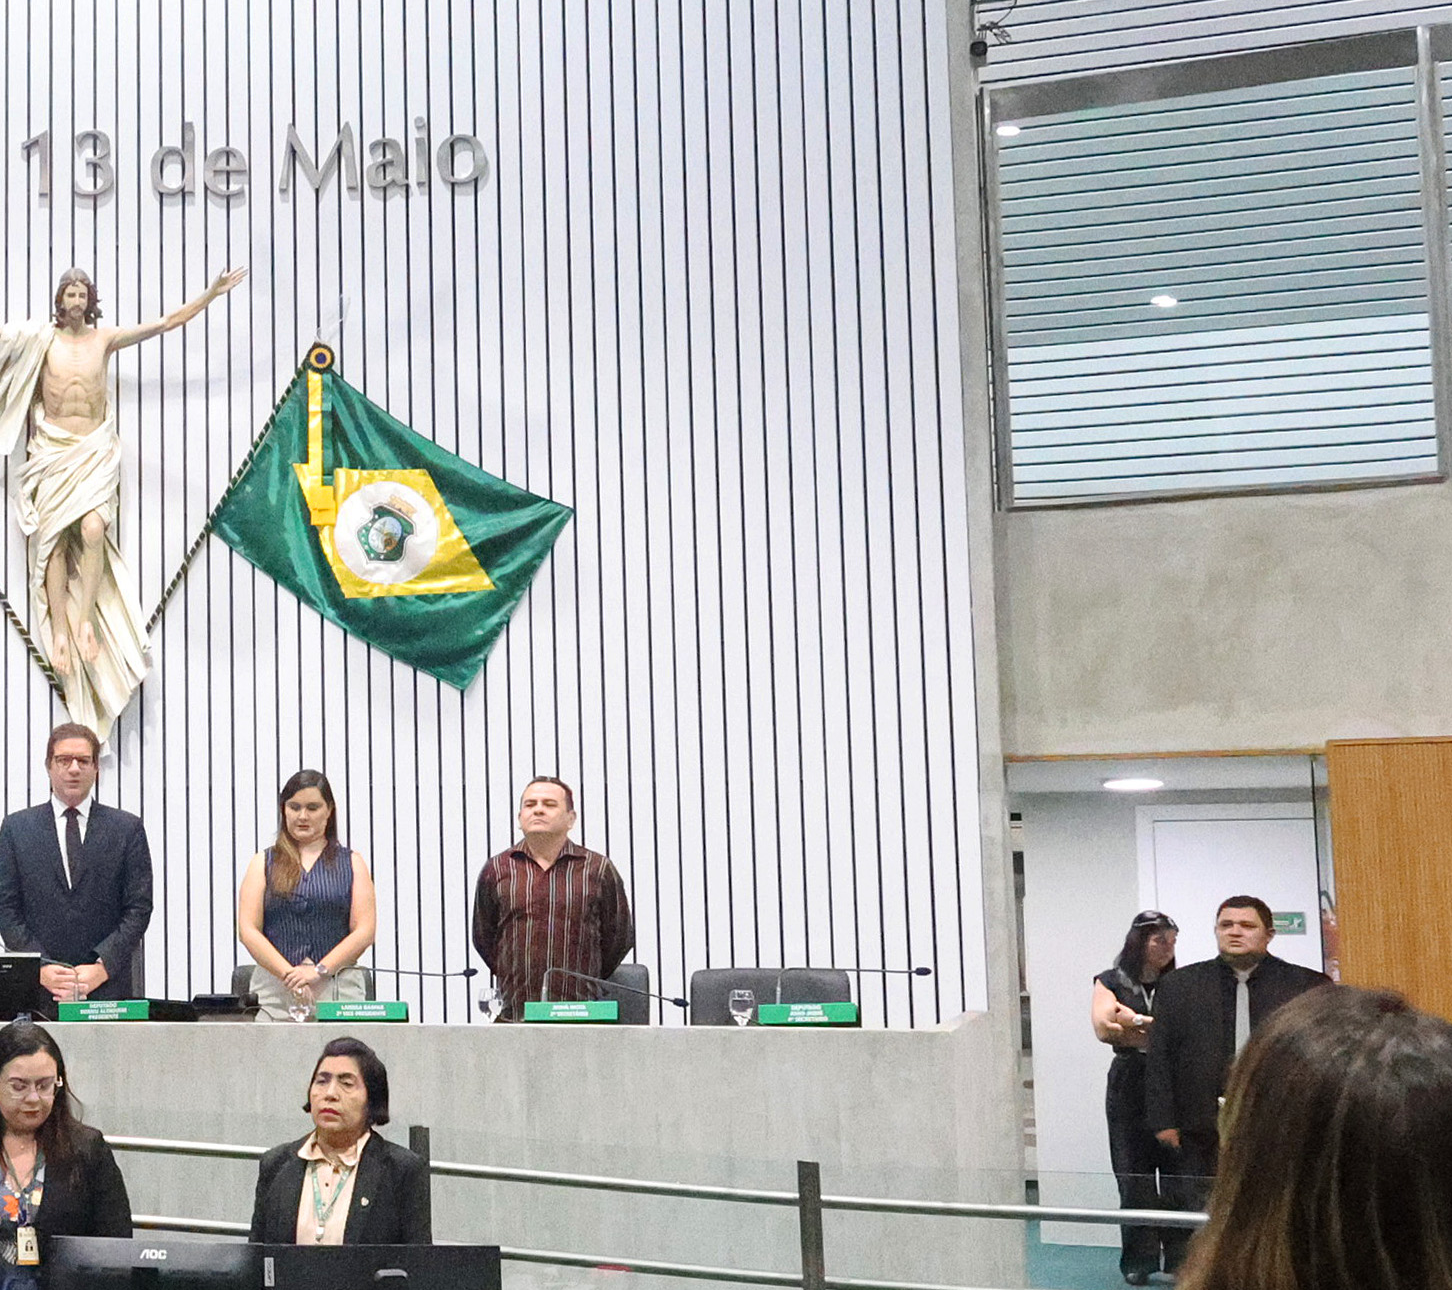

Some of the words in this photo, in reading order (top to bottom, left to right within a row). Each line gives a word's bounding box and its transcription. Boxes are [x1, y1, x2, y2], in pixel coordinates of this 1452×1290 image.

[22, 128, 114, 198] 13
[151, 120, 248, 196] de
[278, 115, 489, 194] Maio
[140, 1249, 167, 1259] AOC
